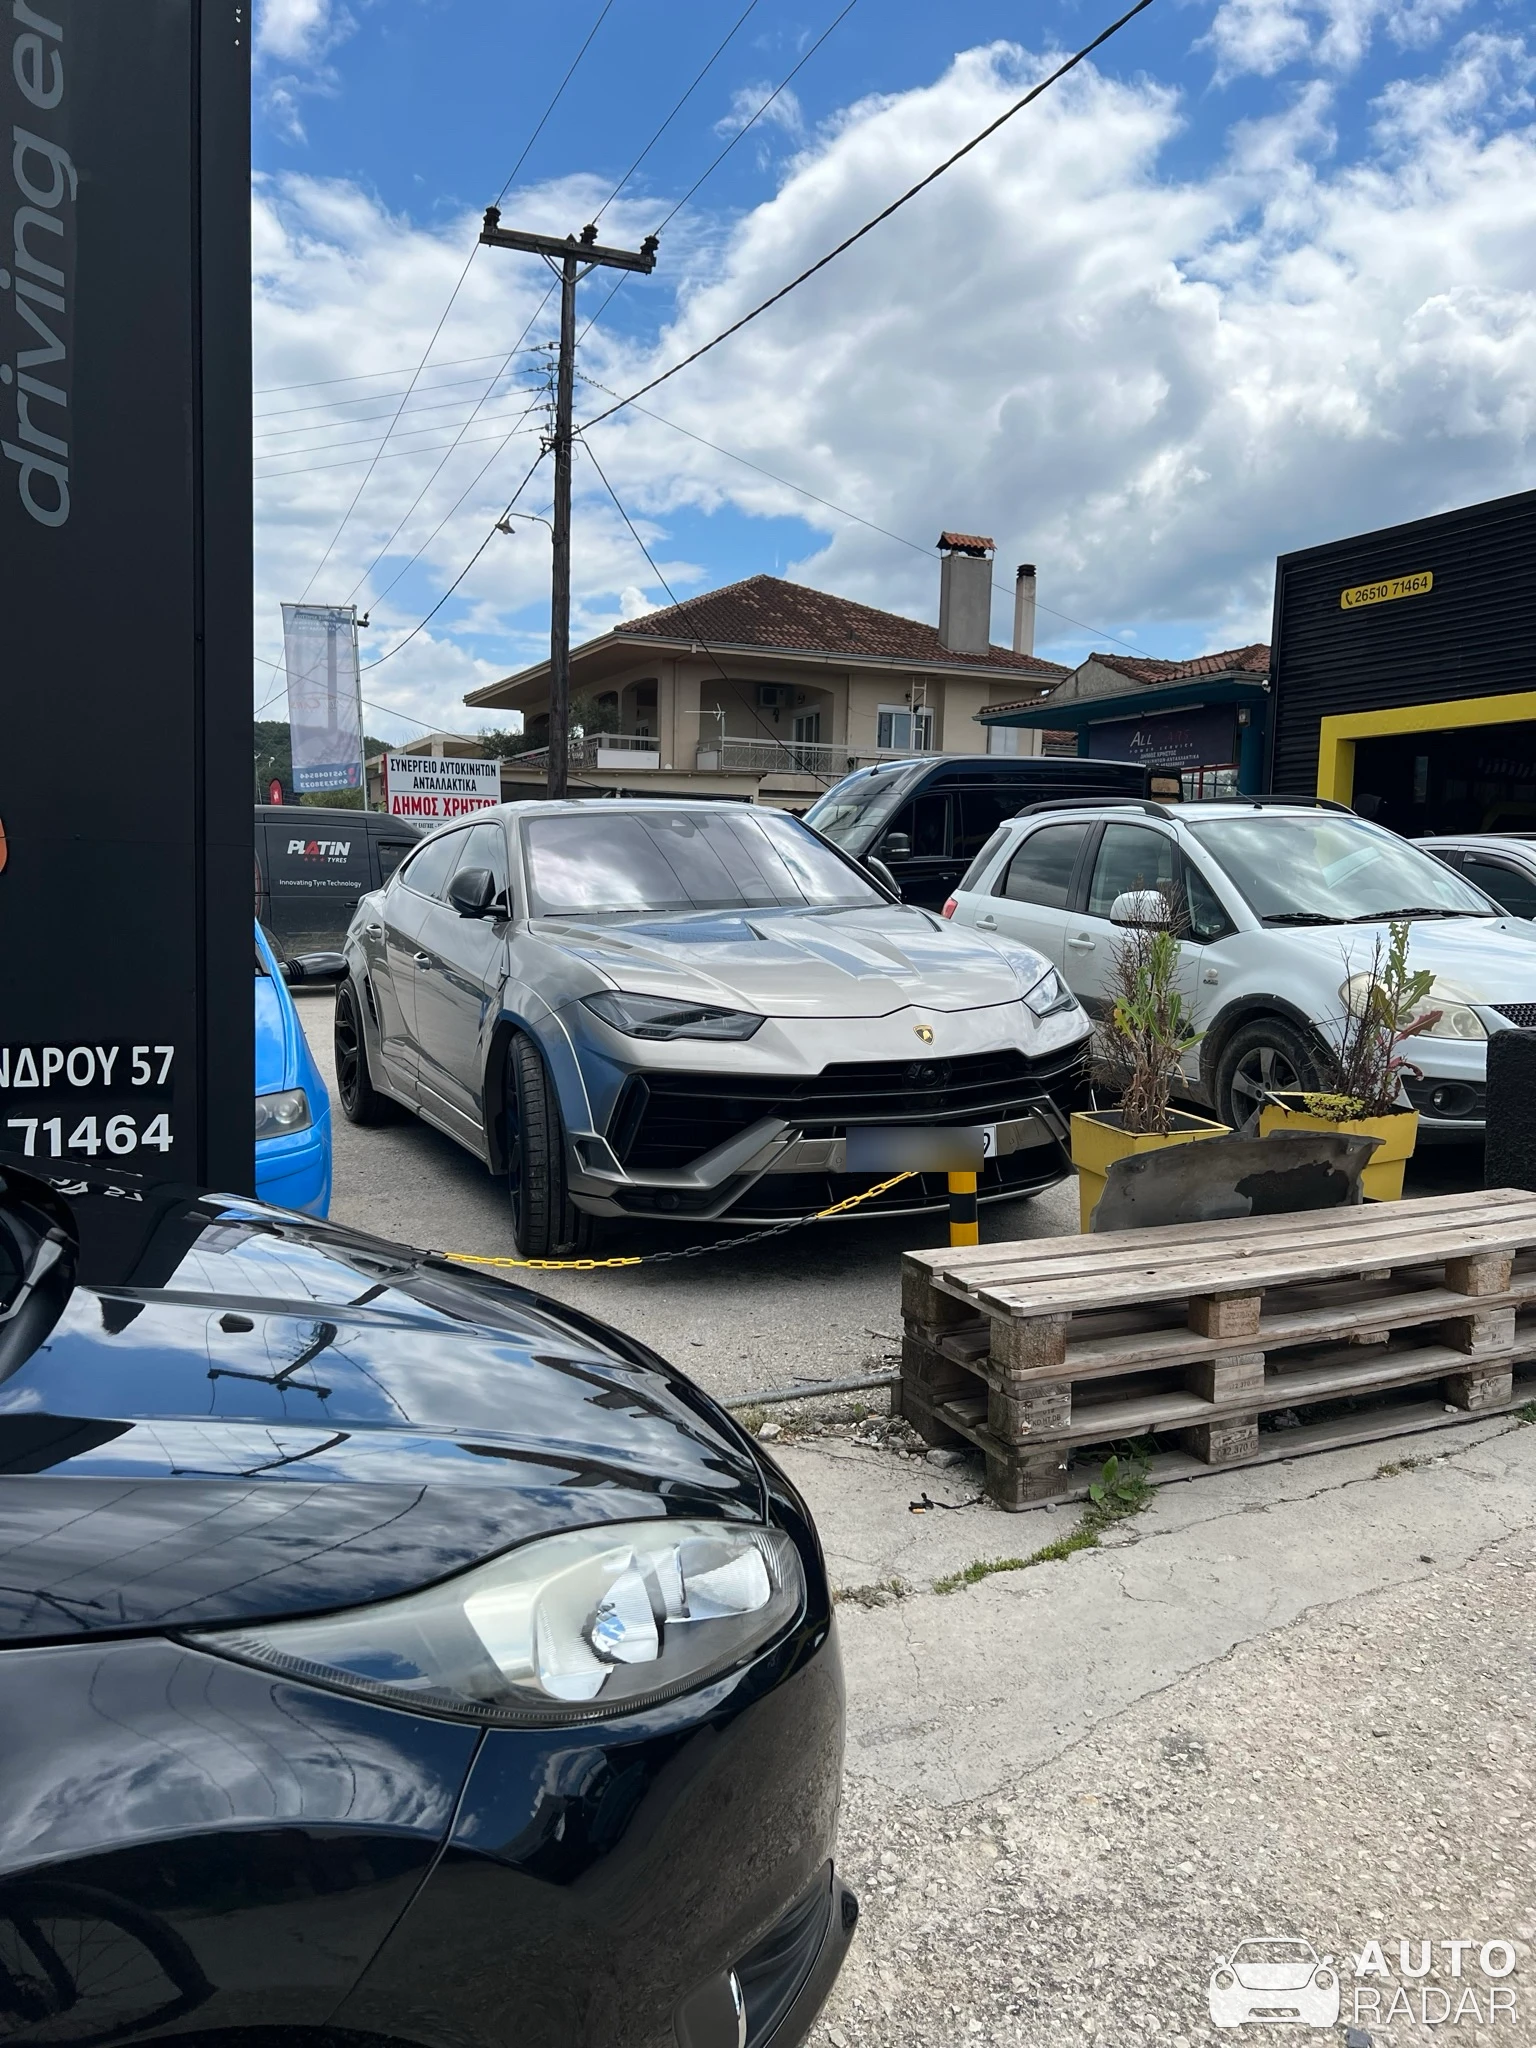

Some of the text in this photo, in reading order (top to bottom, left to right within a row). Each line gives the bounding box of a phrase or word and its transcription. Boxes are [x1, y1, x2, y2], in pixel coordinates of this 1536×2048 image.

[0, 125, 78, 528] driving
[1355, 576, 1428, 603] 26510 71464
[391, 759, 496, 777] ΣΥΝΕΡΓΕΙΟ ΑΥΤΟΚΙΝΗΤΩΝ
[413, 777, 477, 791] ΑΝΤΑΛΛΑΚΤΙΚΑ
[392, 796, 439, 816] ΔΗΜΟΣ
[280, 879, 312, 887] Innovating
[327, 880, 361, 888] Technology
[131, 1046, 175, 1085] 57
[7, 1113, 174, 1157] 71464
